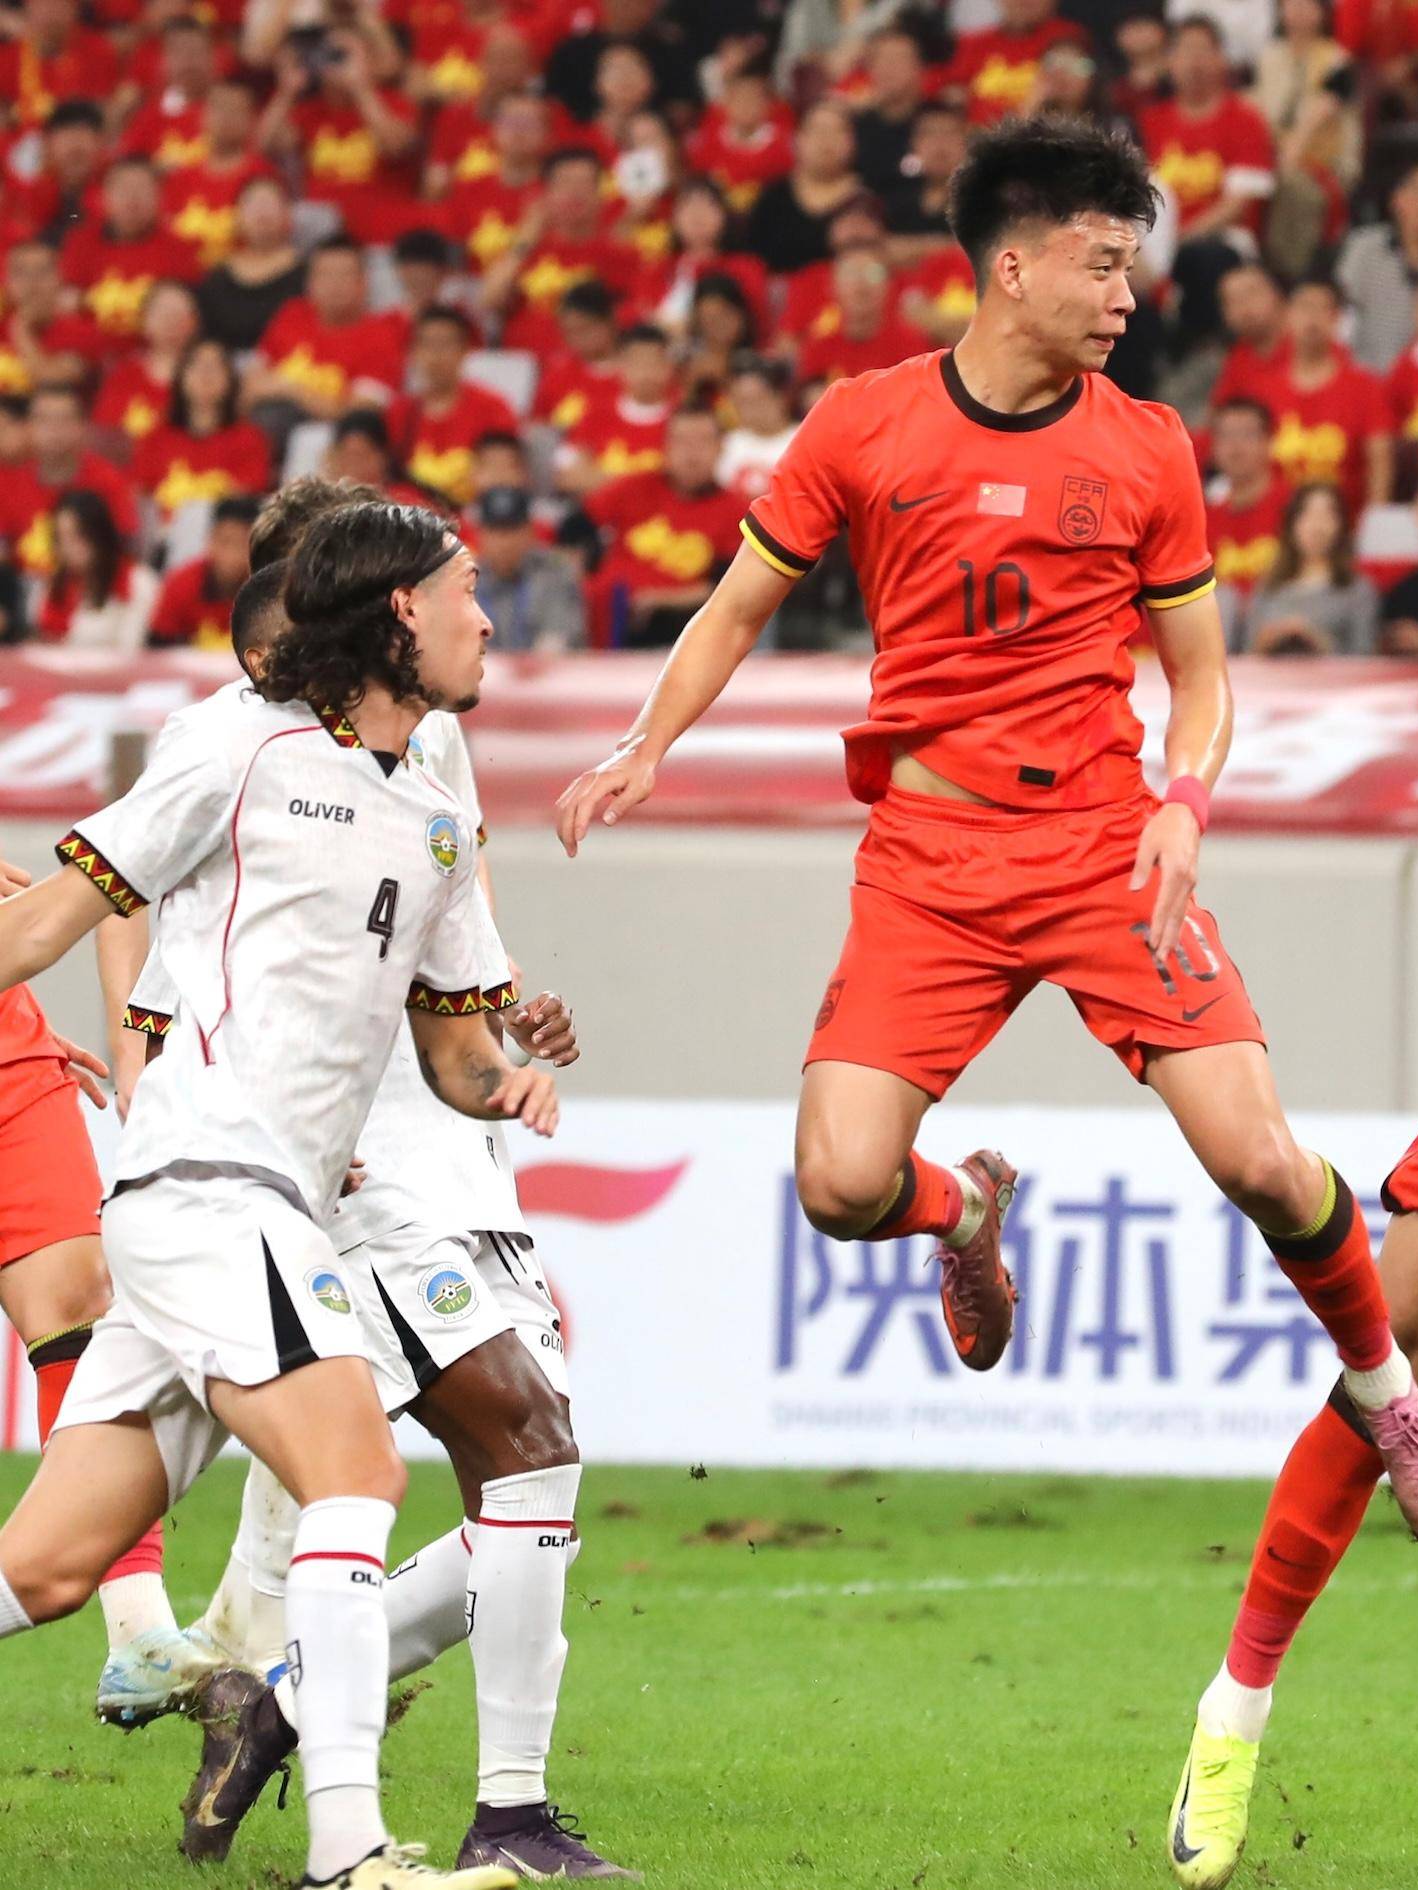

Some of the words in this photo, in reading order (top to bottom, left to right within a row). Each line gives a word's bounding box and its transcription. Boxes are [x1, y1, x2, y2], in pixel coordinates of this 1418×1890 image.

[957, 559, 1030, 637] 10
[366, 877, 400, 962] 4
[1129, 914, 1220, 996] 10
